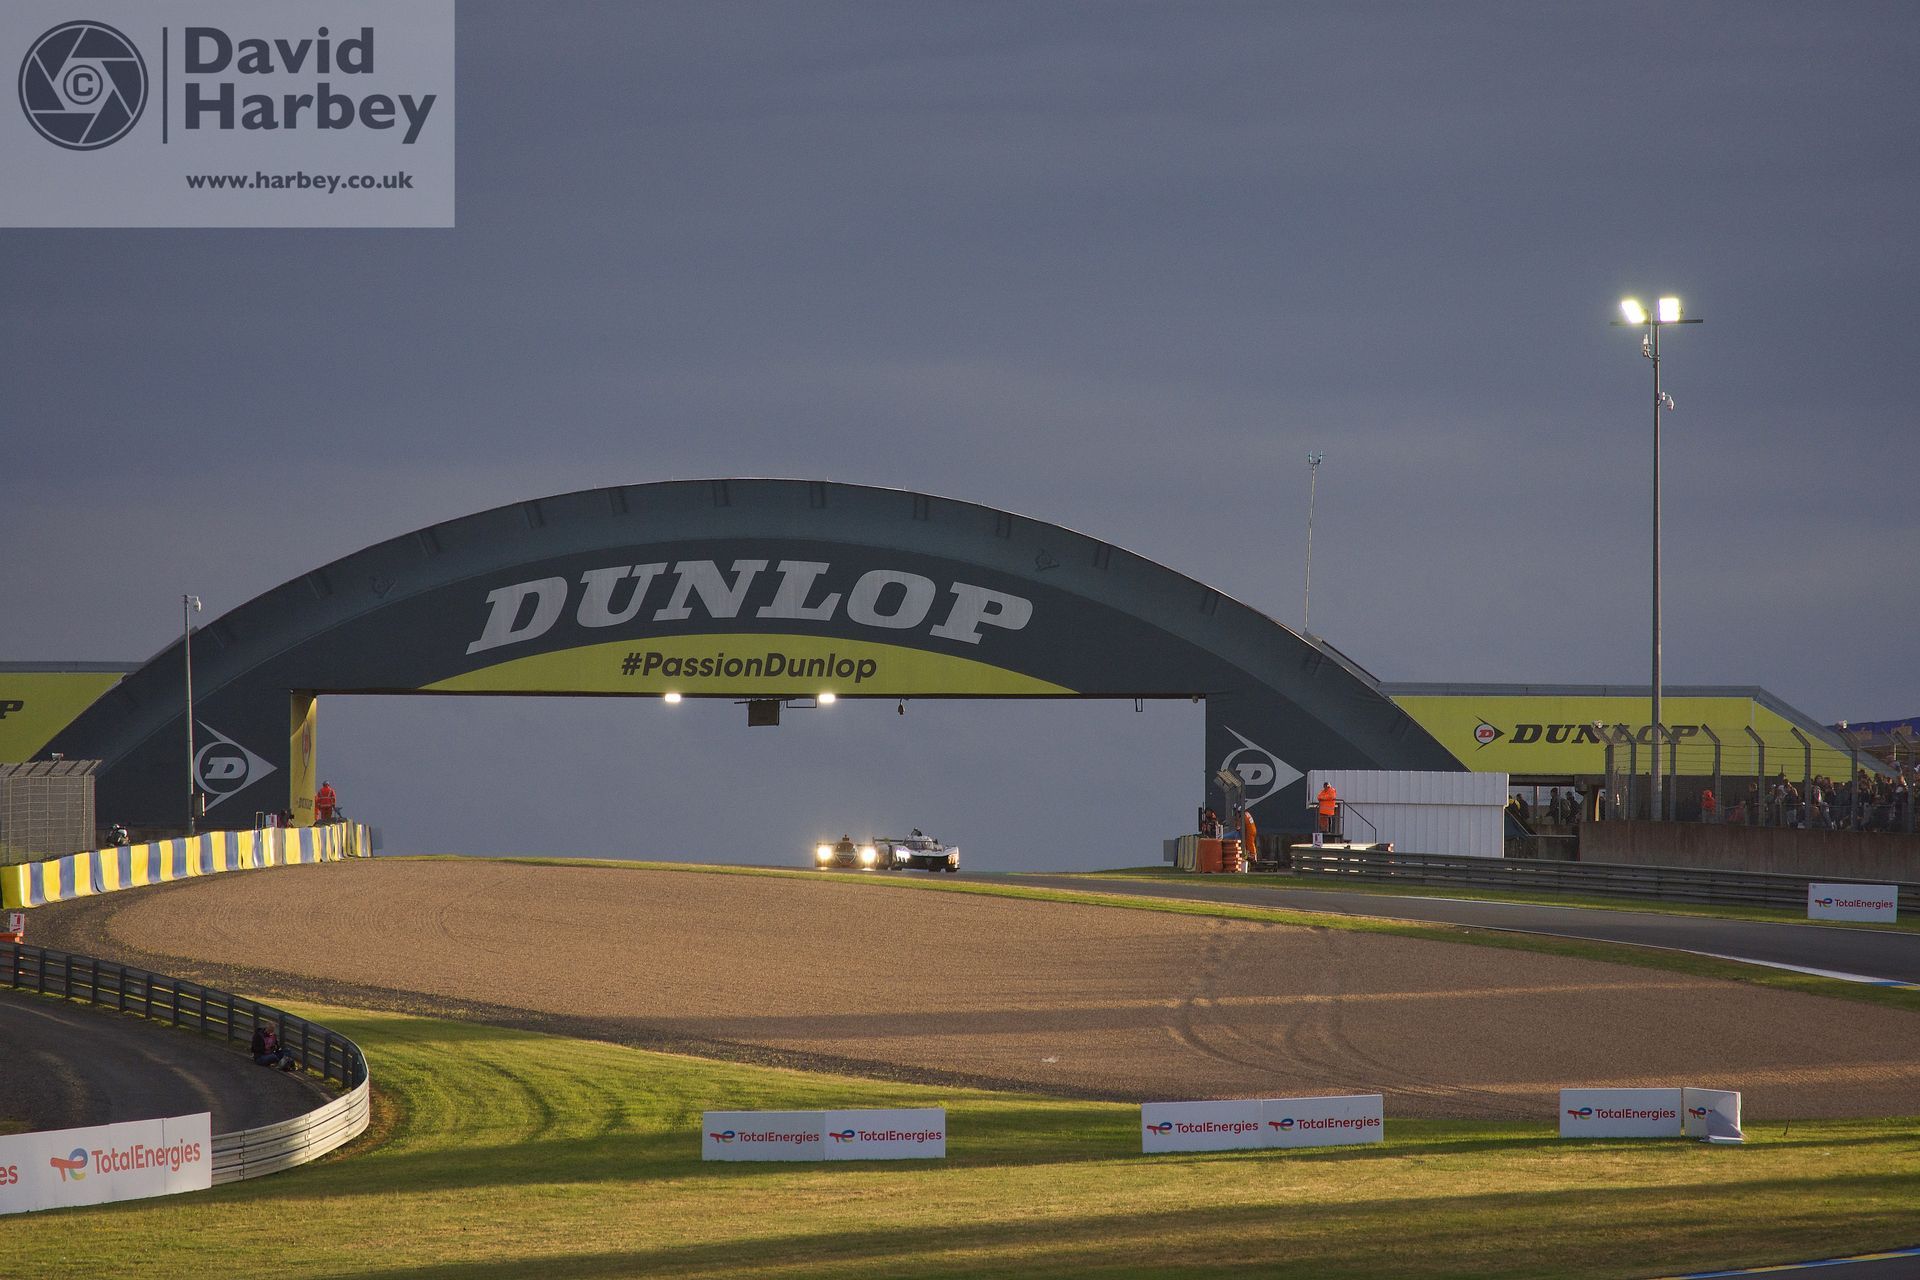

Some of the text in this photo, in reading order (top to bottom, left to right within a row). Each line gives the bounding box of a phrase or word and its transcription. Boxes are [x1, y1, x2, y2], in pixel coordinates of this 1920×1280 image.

[465, 559, 1034, 656] DUNLOP
[621, 652, 877, 684] #PassionDunlop
[204, 757, 246, 780] D
[1834, 898, 1894, 910] TotalEnergies
[1595, 1107, 1676, 1121] TotalEnergies
[1175, 1115, 1380, 1135] TotalEnergies TotalEnergies
[738, 1128, 942, 1145] TotalEnergies TotalEnergies
[91, 1138, 201, 1175] TotalEnergies
